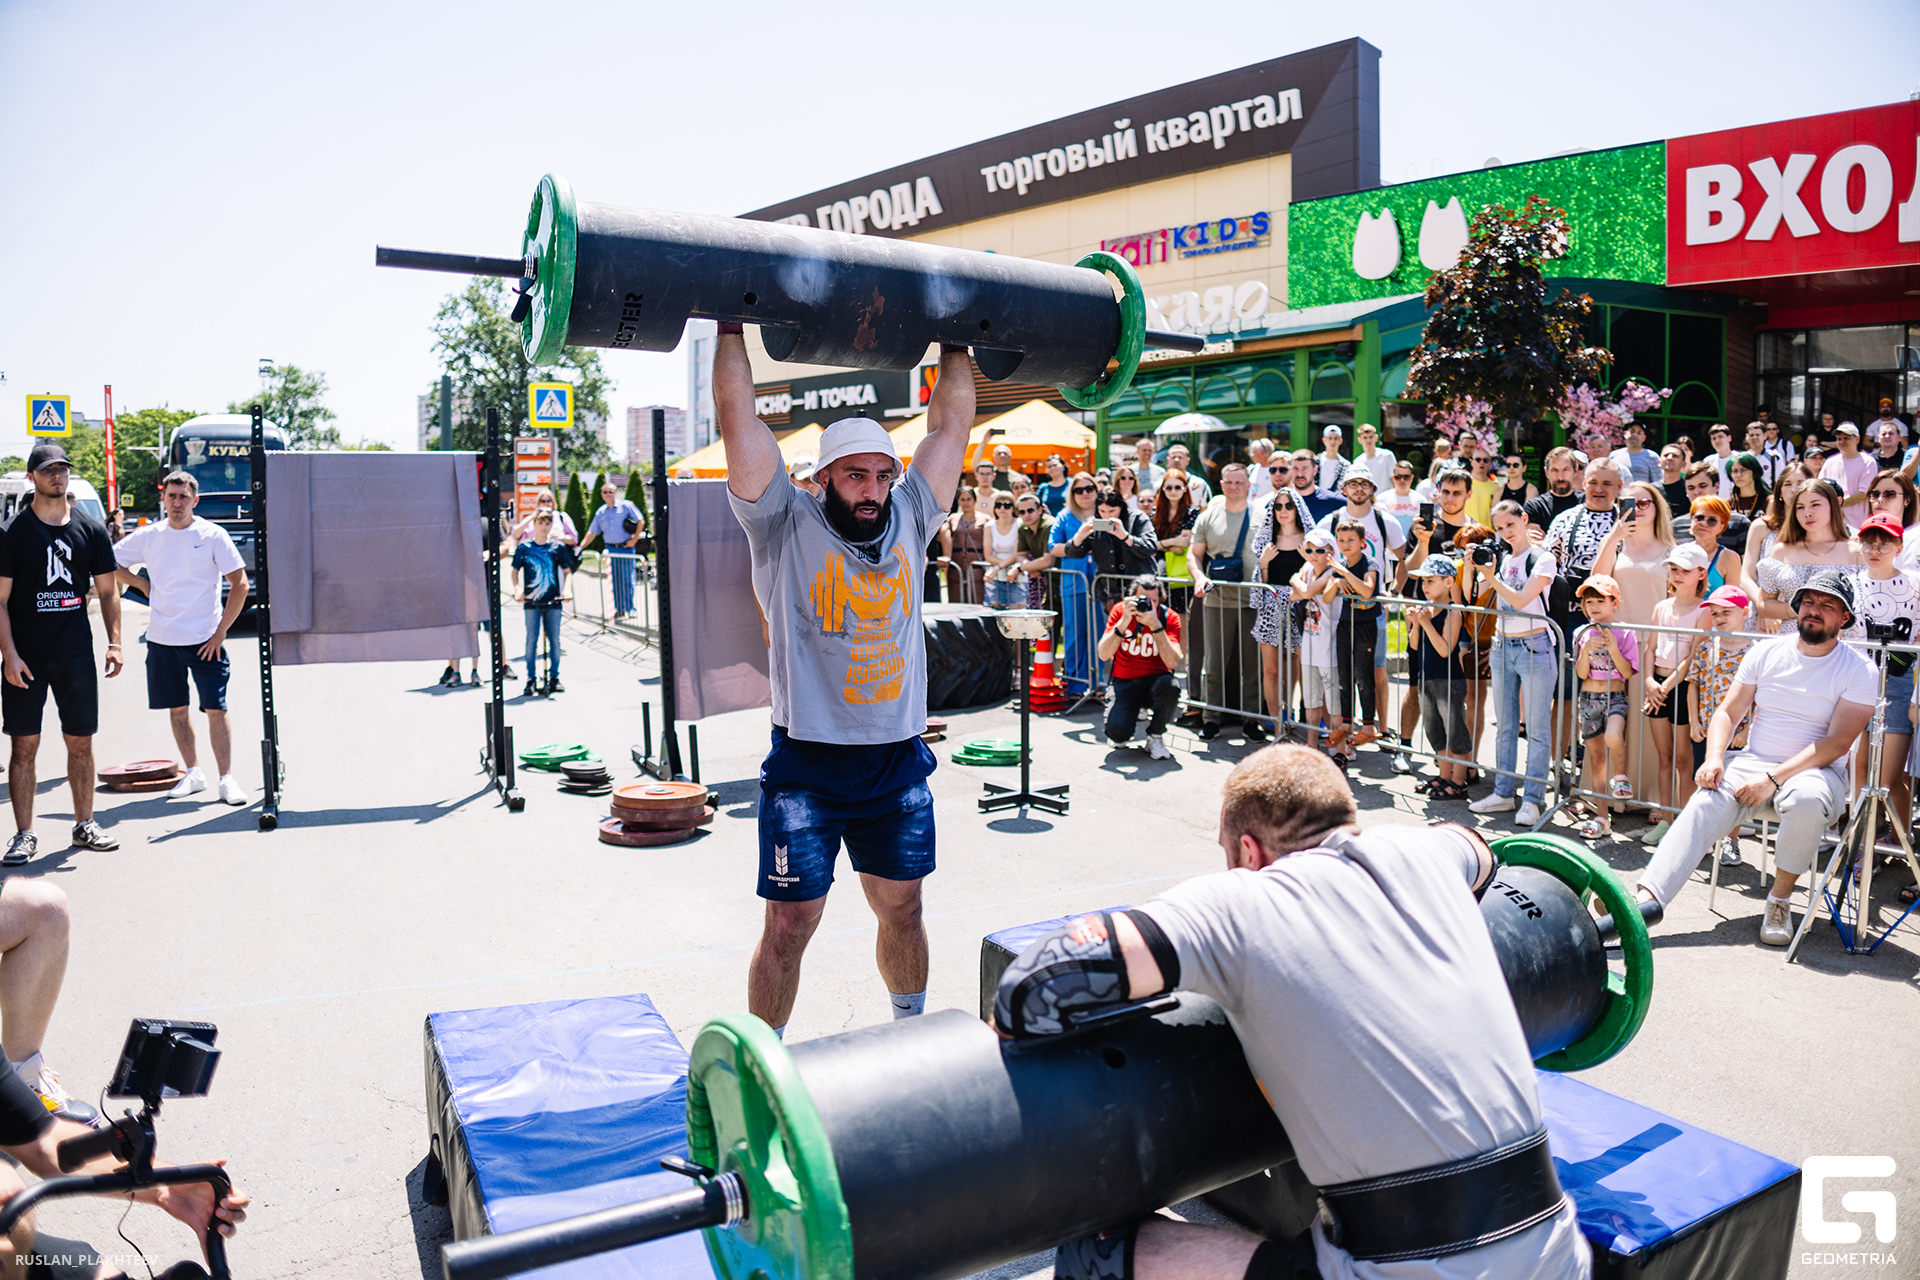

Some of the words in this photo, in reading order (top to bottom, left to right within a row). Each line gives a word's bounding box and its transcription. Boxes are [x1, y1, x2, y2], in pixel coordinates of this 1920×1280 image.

[981, 118, 1138, 196] торговый
[1144, 87, 1303, 150] квартал
[816, 176, 944, 234] ГОРОДА
[1173, 211, 1269, 249] KIDS
[819, 383, 878, 410] ТОЧКА
[208, 445, 251, 457] КУБА
[36, 590, 75, 600] ORIGINAL
[36, 599, 60, 608] GATE
[850, 641, 899, 662] ЧЕЛОВЕК
[845, 656, 906, 685] КУБАНИ
